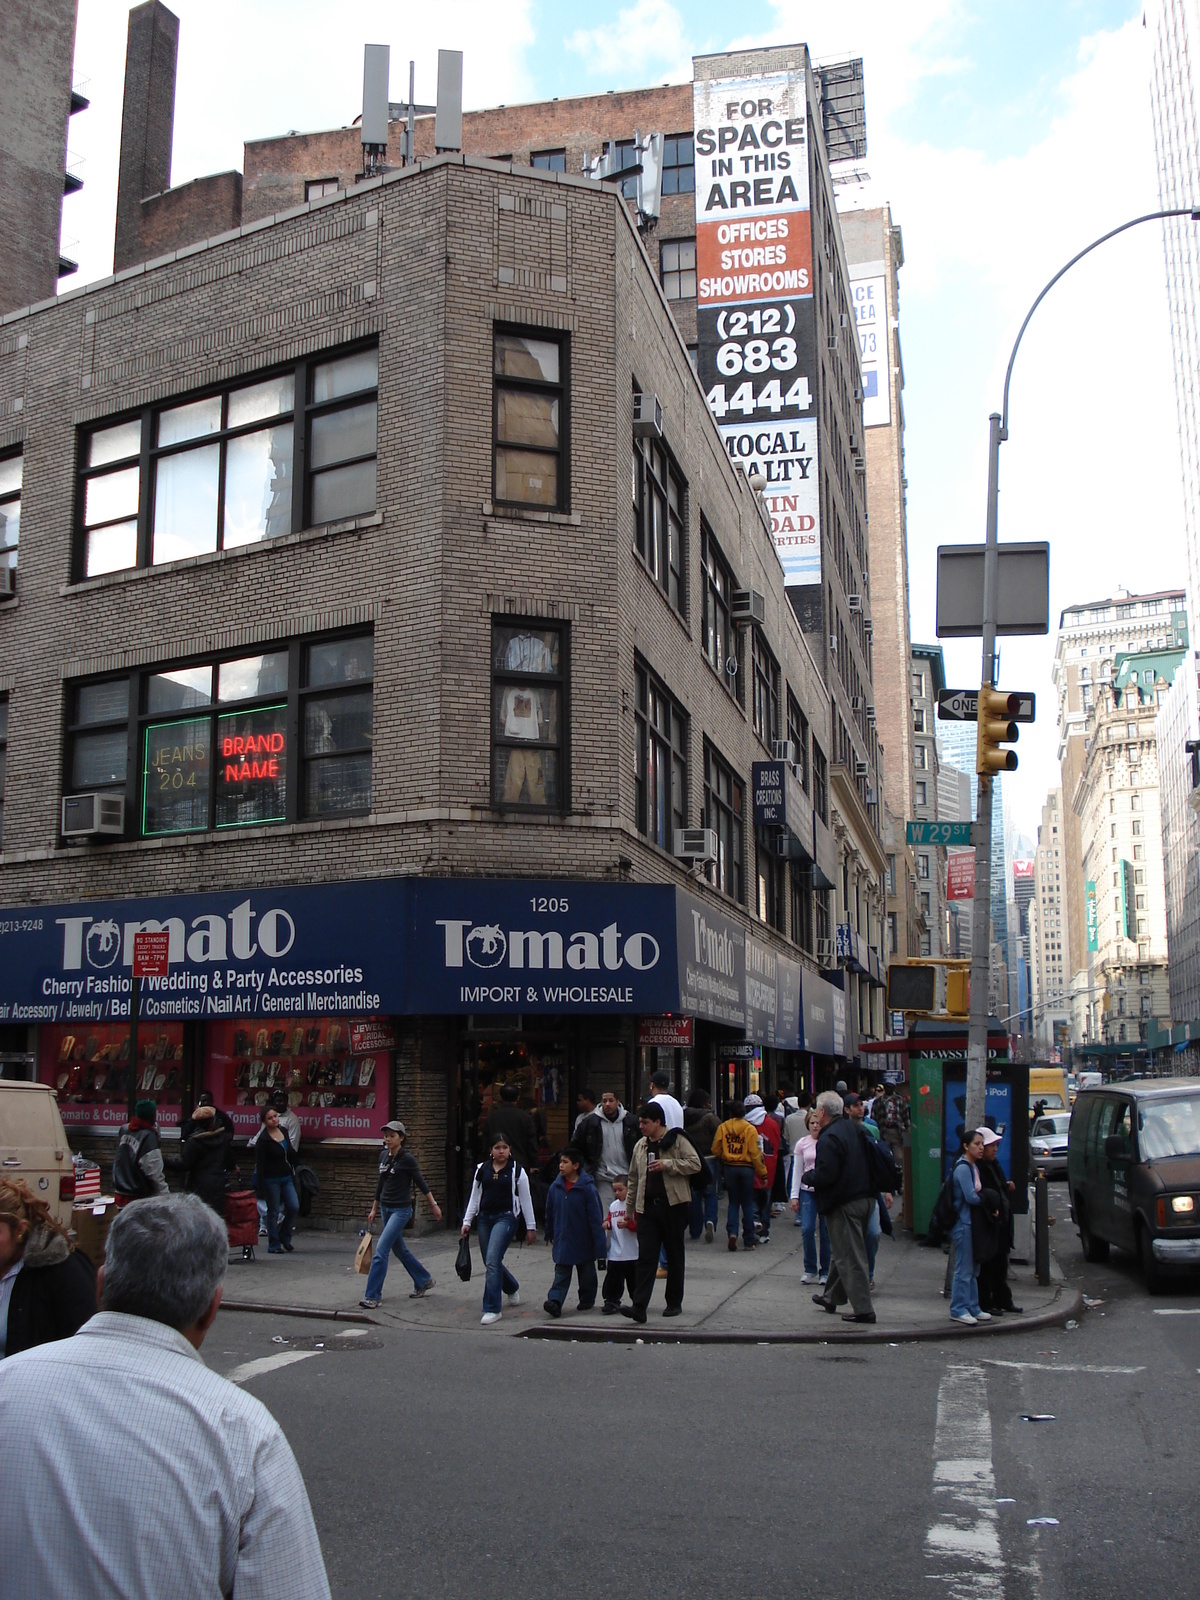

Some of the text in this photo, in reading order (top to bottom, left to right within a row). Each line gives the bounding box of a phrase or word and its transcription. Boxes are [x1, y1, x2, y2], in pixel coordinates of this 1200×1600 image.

[726, 98, 773, 120] FOR
[696, 117, 805, 156] SPACE
[711, 151, 791, 178] IN THIS
[705, 175, 799, 212] AREA
[717, 218, 789, 245] OFFICES
[720, 245, 787, 271] STORES
[699, 267, 809, 298] SHOWROOMS
[716, 303, 796, 340] (212)
[716, 336, 798, 377] 683
[705, 376, 813, 418] 4444
[765, 495, 799, 513] IN
[952, 699, 978, 712] ONE
[152, 744, 205, 767] JEANS
[222, 732, 284, 757] BRAND
[160, 772, 196, 790] 204
[225, 759, 279, 782] NAME
[911, 824, 966, 843] W 29 ST
[530, 898, 569, 912] 1205
[55, 899, 296, 971] Tomato
[435, 920, 660, 971] Tomato
[691, 909, 735, 978] Tomato
[42, 978, 84, 998] Cherry
[87, 974, 132, 994] Fashio
[148, 970, 208, 993] Wedding
[212, 970, 223, 989] &
[226, 968, 264, 992] Party
[268, 964, 364, 987] Accessories
[460, 986, 633, 1002] IMPORT & WHOLESALE
[12, 1003, 58, 1022] Accessory
[66, 1000, 103, 1020] Jewelry
[111, 999, 130, 1016] Bel
[146, 996, 200, 1016] Cosmetics
[208, 994, 232, 1014] Nail
[234, 994, 251, 1012] Art
[262, 992, 304, 1012] General
[307, 990, 380, 1011] Merchandise
[354, 1024, 389, 1033] JEWEL
[640, 1036, 690, 1044] ACCESSORIES
[650, 1028, 678, 1036] BRIDAL
[920, 1049, 997, 1059] NEWSSTD
[990, 1088, 1008, 1097] iPod
[92, 1110, 100, 1120] &
[102, 1109, 128, 1121] Cher
[226, 1111, 370, 1128] Tomat erry Fashion
